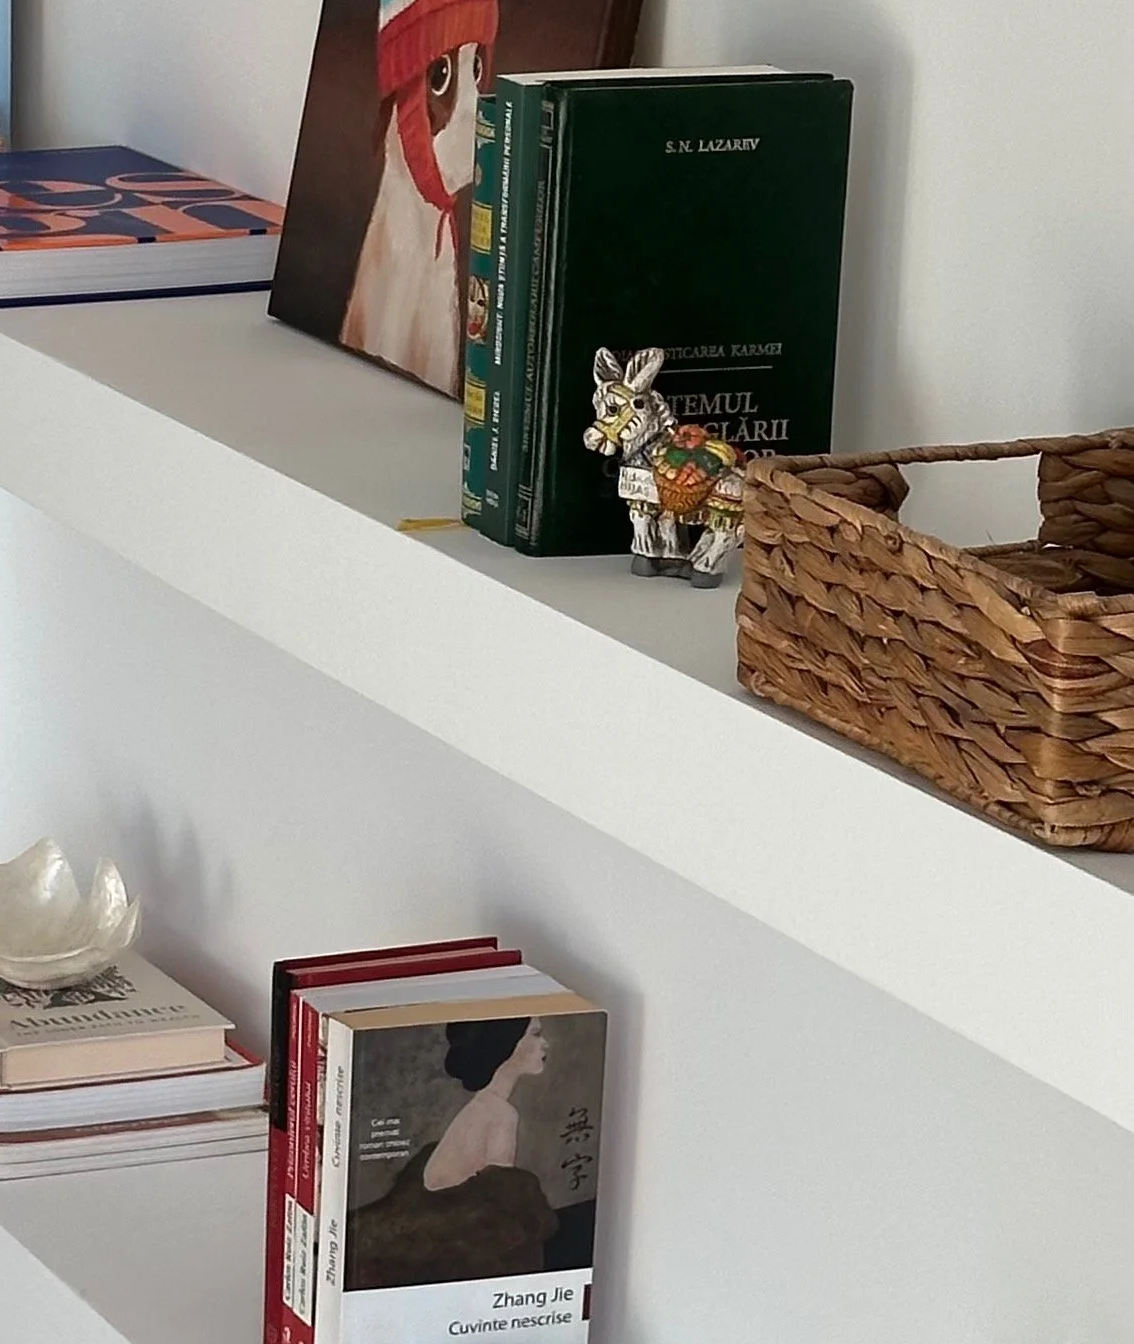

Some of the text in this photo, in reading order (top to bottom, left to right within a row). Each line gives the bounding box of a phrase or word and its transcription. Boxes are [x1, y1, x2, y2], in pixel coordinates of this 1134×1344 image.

[698, 137, 761, 153] LAZAREV
[731, 342, 782, 357] KARMEI
[667, 391, 758, 416] TEMUL
[10, 1004, 185, 1030] Abundance
[325, 1218, 339, 1286] Zhang Jie
[492, 1287, 574, 1309] Zhang Jie
[448, 1311, 572, 1336] Cuvinte nescrise
